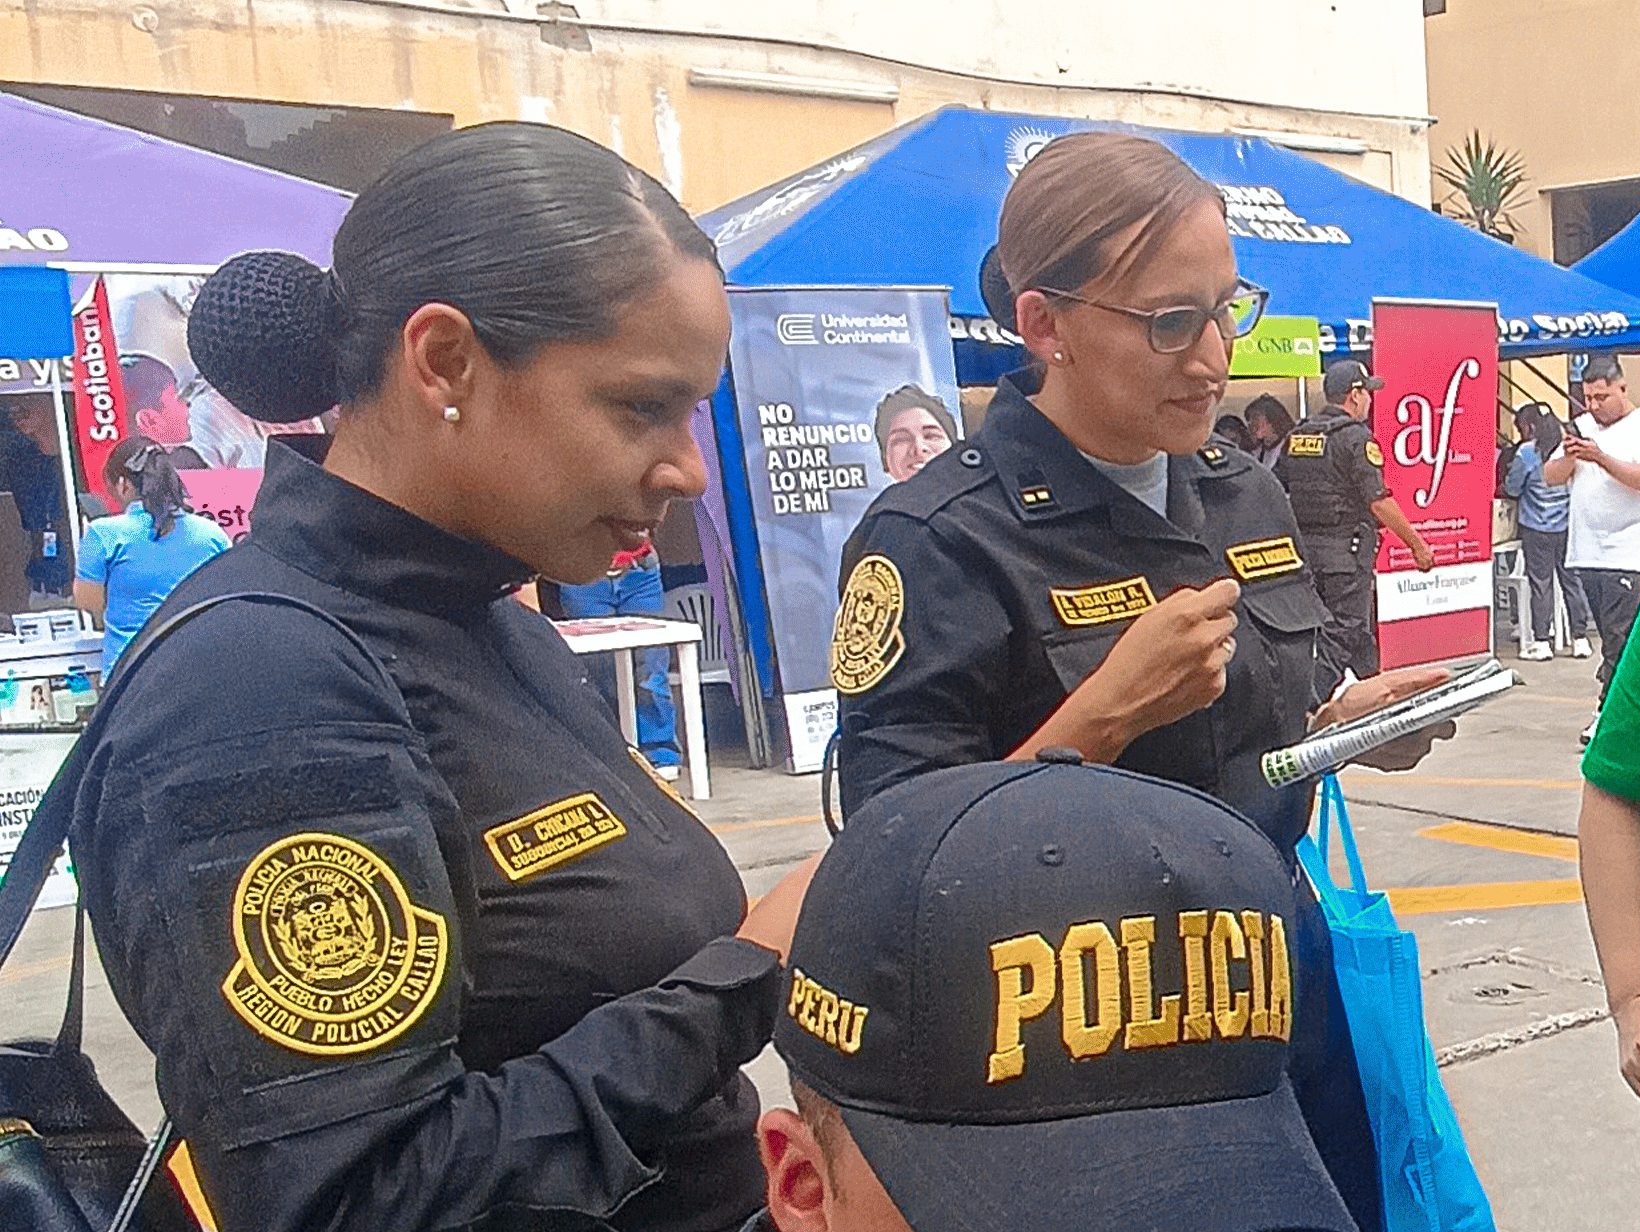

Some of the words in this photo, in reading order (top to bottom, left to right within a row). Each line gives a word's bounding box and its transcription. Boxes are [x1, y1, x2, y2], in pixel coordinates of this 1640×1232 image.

[820, 313, 908, 329] Universidad
[823, 329, 911, 345] Continental
[1257, 337, 1293, 353] GNB
[80, 300, 120, 442] Scotiaban
[758, 403, 793, 426] NO
[763, 423, 872, 446] RENUNCIO
[768, 450, 783, 470] A
[787, 448, 830, 467] DAR
[769, 471, 796, 491] LO
[800, 466, 866, 489] MEJOR
[773, 492, 801, 514] DE
[243, 857, 288, 915] POLICIA
[291, 845, 380, 884] NACIONAL
[269, 974, 333, 1012] PUEBLO
[342, 970, 395, 1012] HECHO
[387, 936, 409, 966] LEY
[237, 984, 303, 1036] REGION
[311, 1005, 404, 1043] POLICIAL
[400, 935, 439, 1001] CALLAO
[986, 909, 1293, 1083] POLICIA
[787, 968, 868, 1055] PERU
